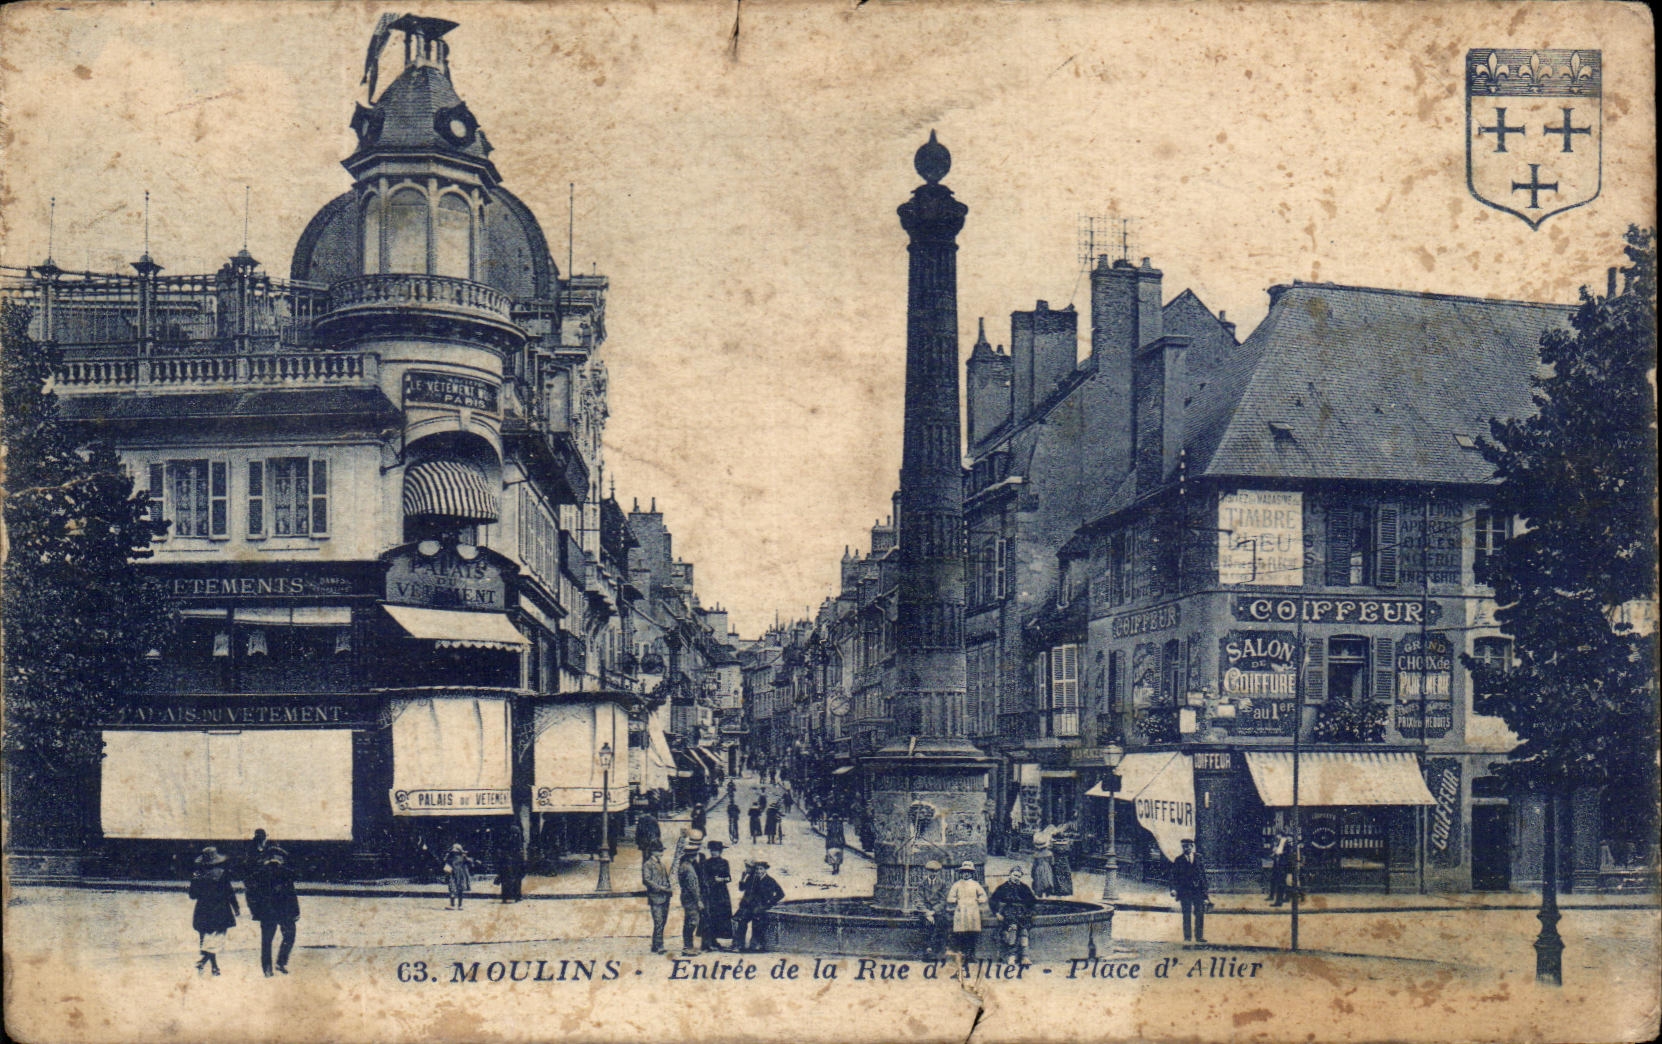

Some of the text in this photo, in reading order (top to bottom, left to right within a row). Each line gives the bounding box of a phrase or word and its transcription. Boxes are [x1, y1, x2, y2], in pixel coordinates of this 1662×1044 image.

[444, 394, 487, 408] PARIS
[1225, 507, 1298, 530] TIMBRE
[411, 561, 487, 579] PALAIS
[173, 578, 304, 594] ETEMENTS
[1250, 599, 1423, 622] COIFFEUR
[1114, 606, 1177, 637] COIFFEUR
[1225, 637, 1296, 664] SALON
[1404, 640, 1446, 653] GRND
[1251, 659, 1267, 668] DE
[1223, 666, 1297, 695] COIFFURE
[1253, 707, 1270, 720] au
[418, 792, 454, 806] PALAIS
[1430, 766, 1461, 852] COIFFEUR
[1137, 798, 1194, 827] COIFFEUR
